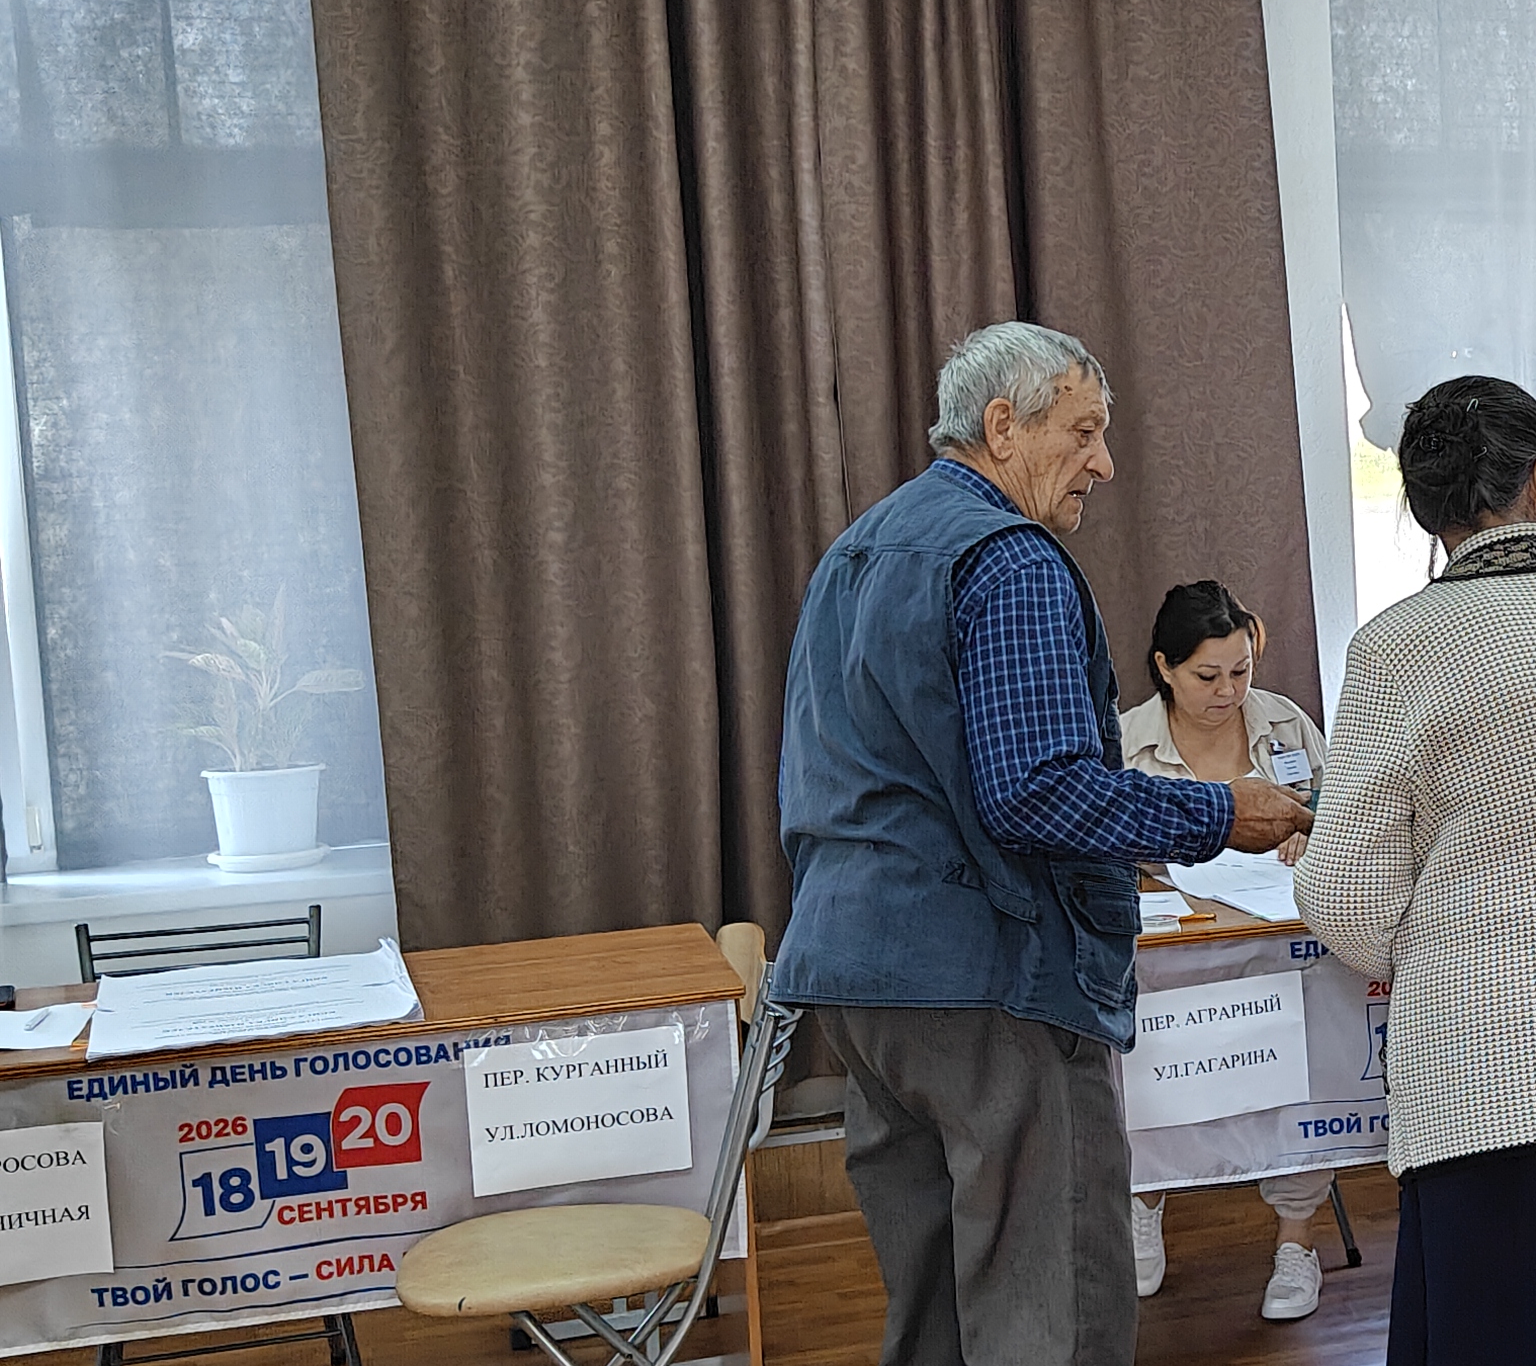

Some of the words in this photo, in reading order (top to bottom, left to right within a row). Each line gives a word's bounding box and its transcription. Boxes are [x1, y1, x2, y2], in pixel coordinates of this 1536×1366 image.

[1141, 1014, 1180, 1033] ПЕР.
[1185, 993, 1282, 1026] АГРАРНЫЙ
[67, 1063, 200, 1102] ЕДИНЫЙ
[208, 1059, 288, 1089] ДЕНЬ
[484, 1071, 530, 1088] ПЕР.
[536, 1049, 669, 1083] КУРГАННЫЙ
[1153, 1047, 1278, 1081] УЛ.ГАГАРИНА
[178, 1115, 249, 1144] 2026
[338, 1102, 413, 1151] 20
[485, 1105, 675, 1143] УЛ.ЛОМОНОСОВА
[1298, 1112, 1362, 1139] ТВОЙ
[0, 1149, 88, 1173] ОСОВА
[264, 1133, 327, 1181] 19
[191, 1167, 256, 1217] 18
[277, 1191, 428, 1225] СЕНТЯБРЯ
[91, 1277, 173, 1308] ТВОЙ
[182, 1269, 281, 1297] ГОЛОС
[315, 1253, 395, 1281] СИЛА
